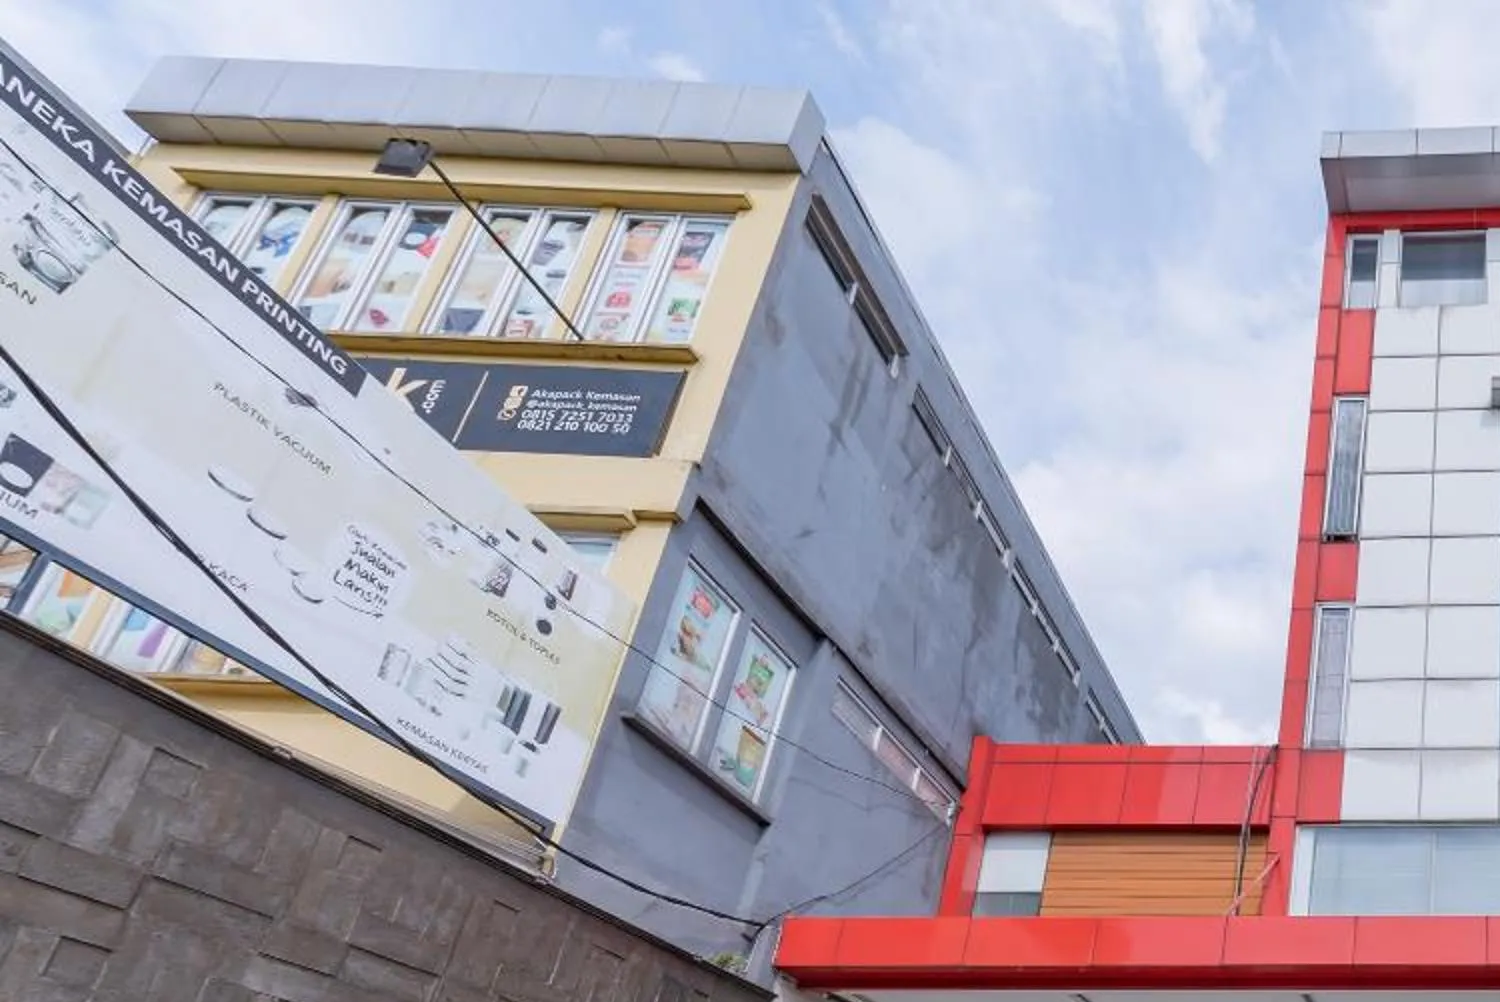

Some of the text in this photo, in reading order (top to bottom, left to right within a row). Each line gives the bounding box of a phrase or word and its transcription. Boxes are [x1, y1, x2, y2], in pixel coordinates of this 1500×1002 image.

[0, 63, 95, 163] NEKA
[103, 159, 240, 282] KEMASAN
[242, 282, 348, 375] PRINTING
[585, 390, 641, 402] Kemasan
[521, 409, 555, 421] 0815
[273, 425, 332, 475] VACUUM
